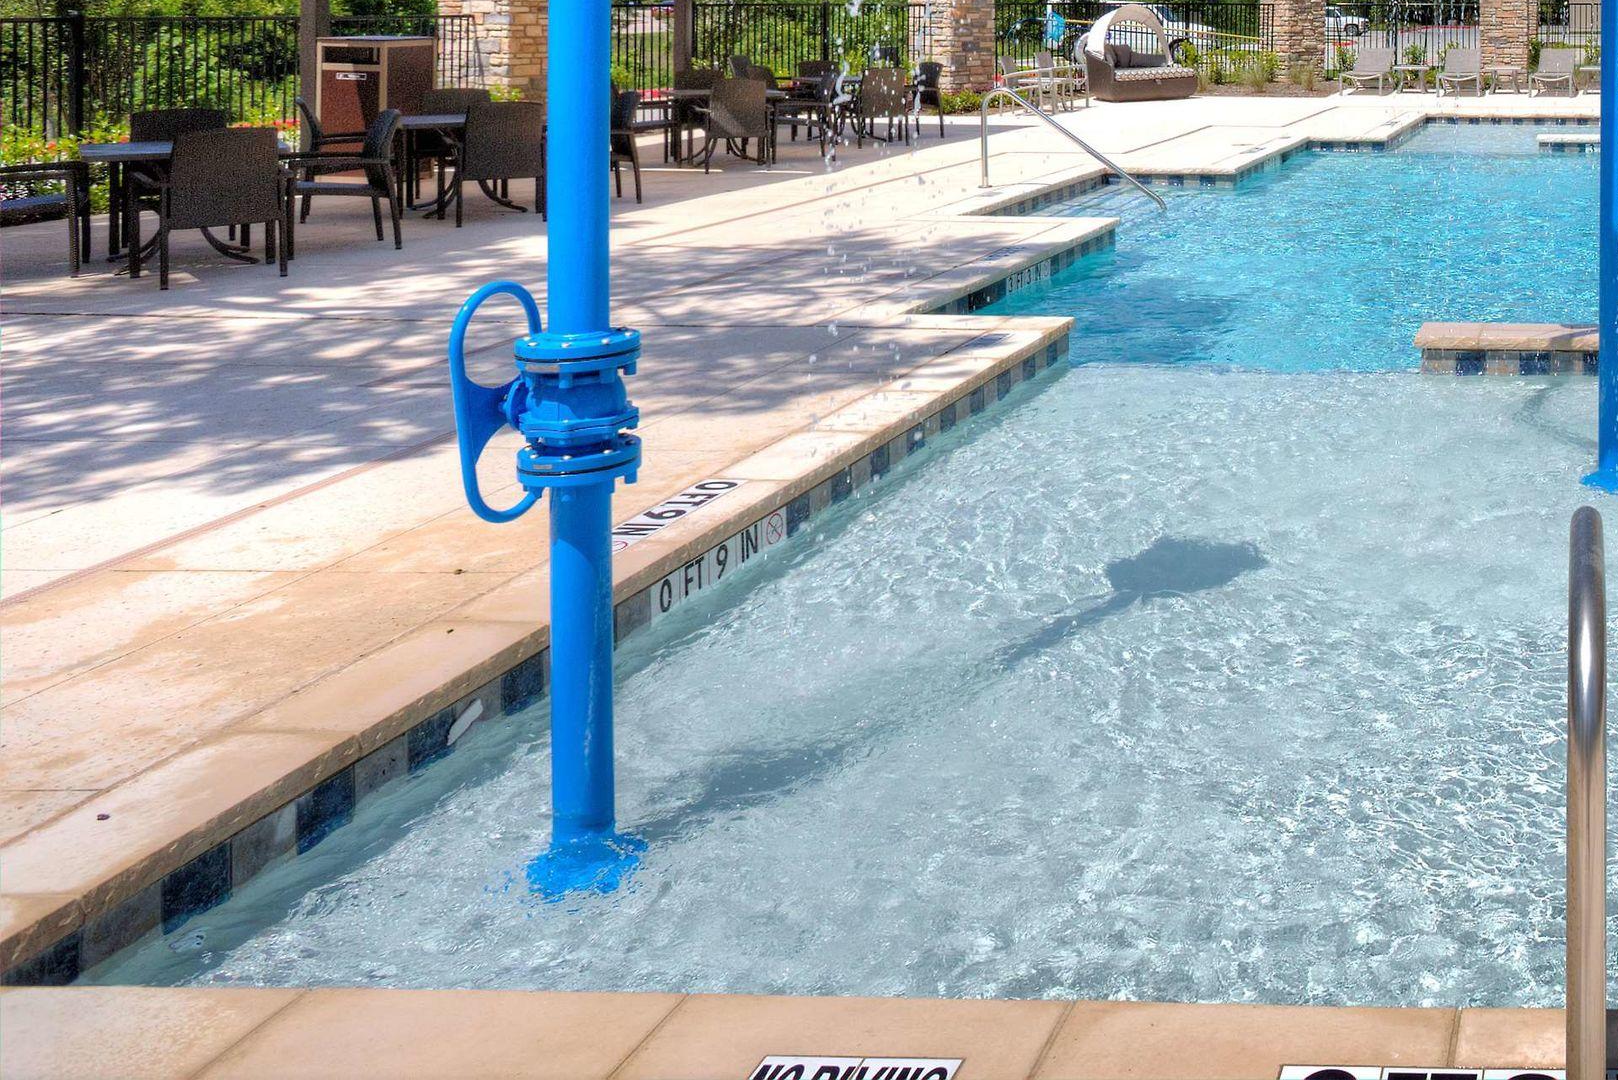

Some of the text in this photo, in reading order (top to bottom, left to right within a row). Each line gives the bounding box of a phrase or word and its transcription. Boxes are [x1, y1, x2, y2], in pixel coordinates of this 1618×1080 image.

[660, 493, 720, 508] FT
[612, 523, 666, 536] IN
[683, 556, 705, 598] FT
[715, 544, 729, 580] 9
[740, 524, 759, 563] IN
